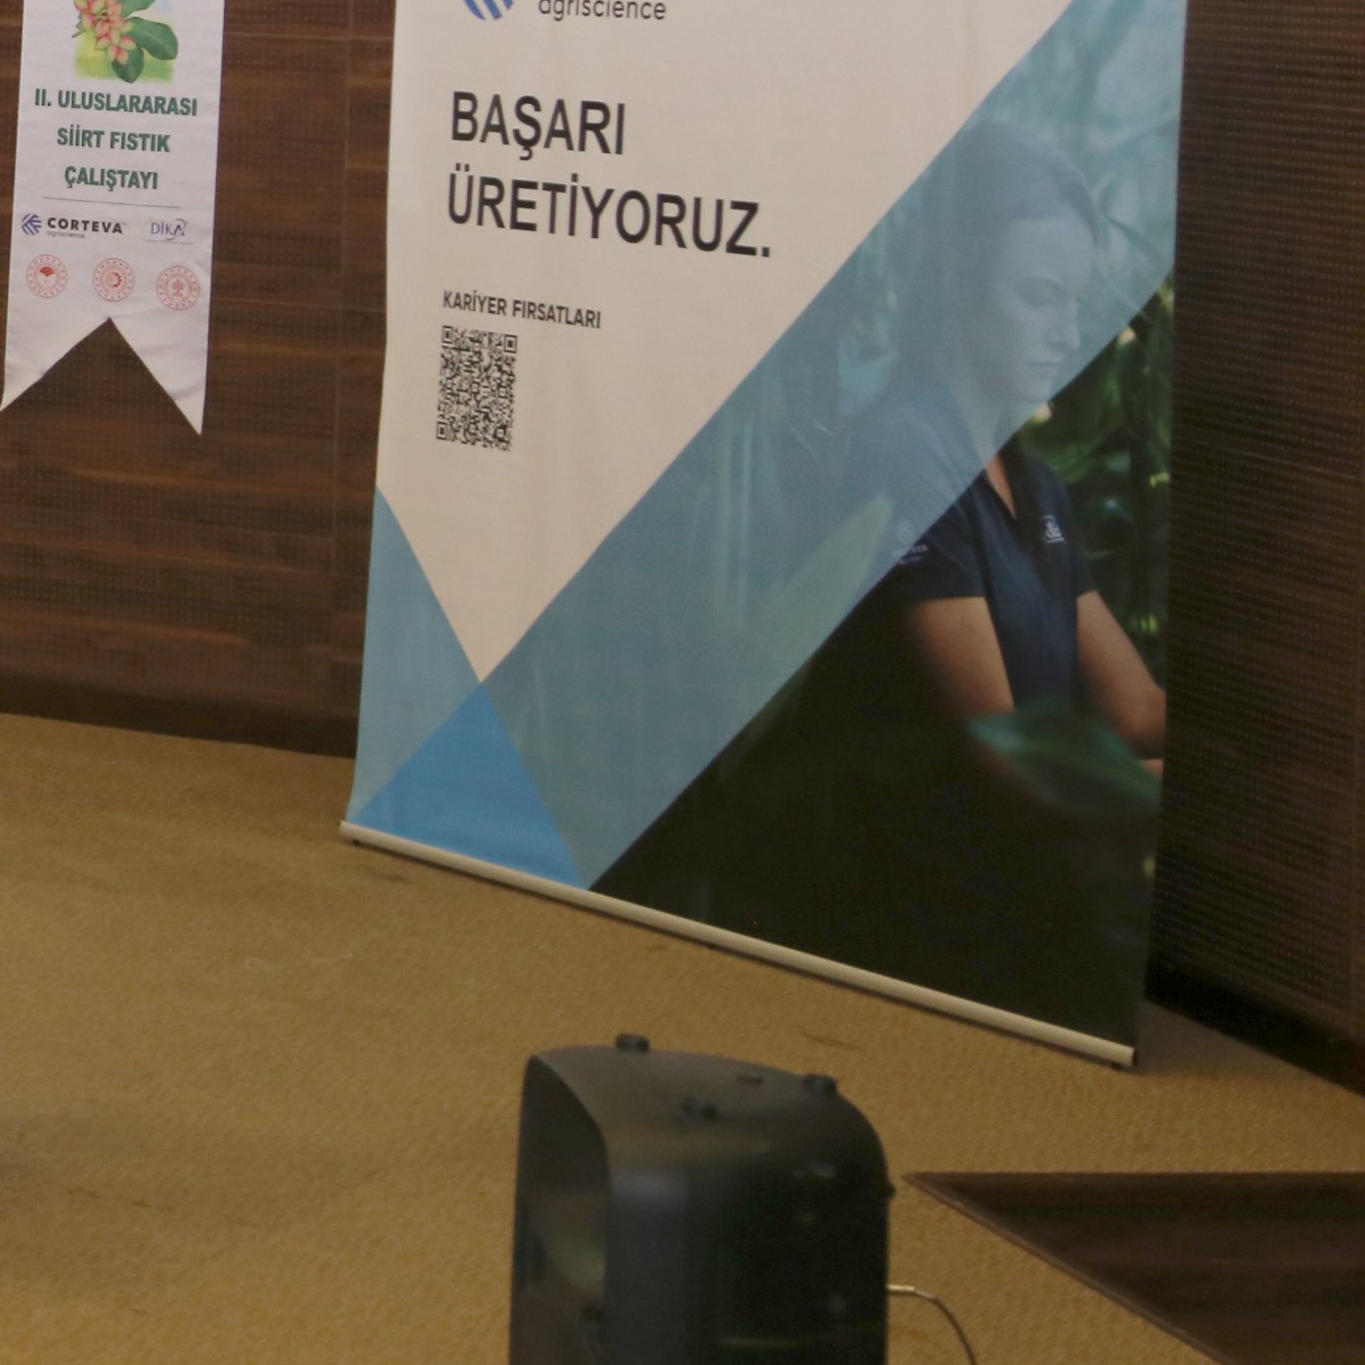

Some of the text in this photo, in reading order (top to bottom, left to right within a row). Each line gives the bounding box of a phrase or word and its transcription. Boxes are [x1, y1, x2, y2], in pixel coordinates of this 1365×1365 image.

[35, 88, 198, 116] II. ULUSLARARASI
[451, 91, 626, 161] BAŞARI
[110, 132, 171, 152] FISTIK
[64, 165, 159, 192] ÇALIŞTAYI
[448, 162, 771, 258] ÜRETİYORUZ.
[47, 217, 123, 234] CORTEVA
[442, 289, 602, 329] KARİYER FIRSATLARI
